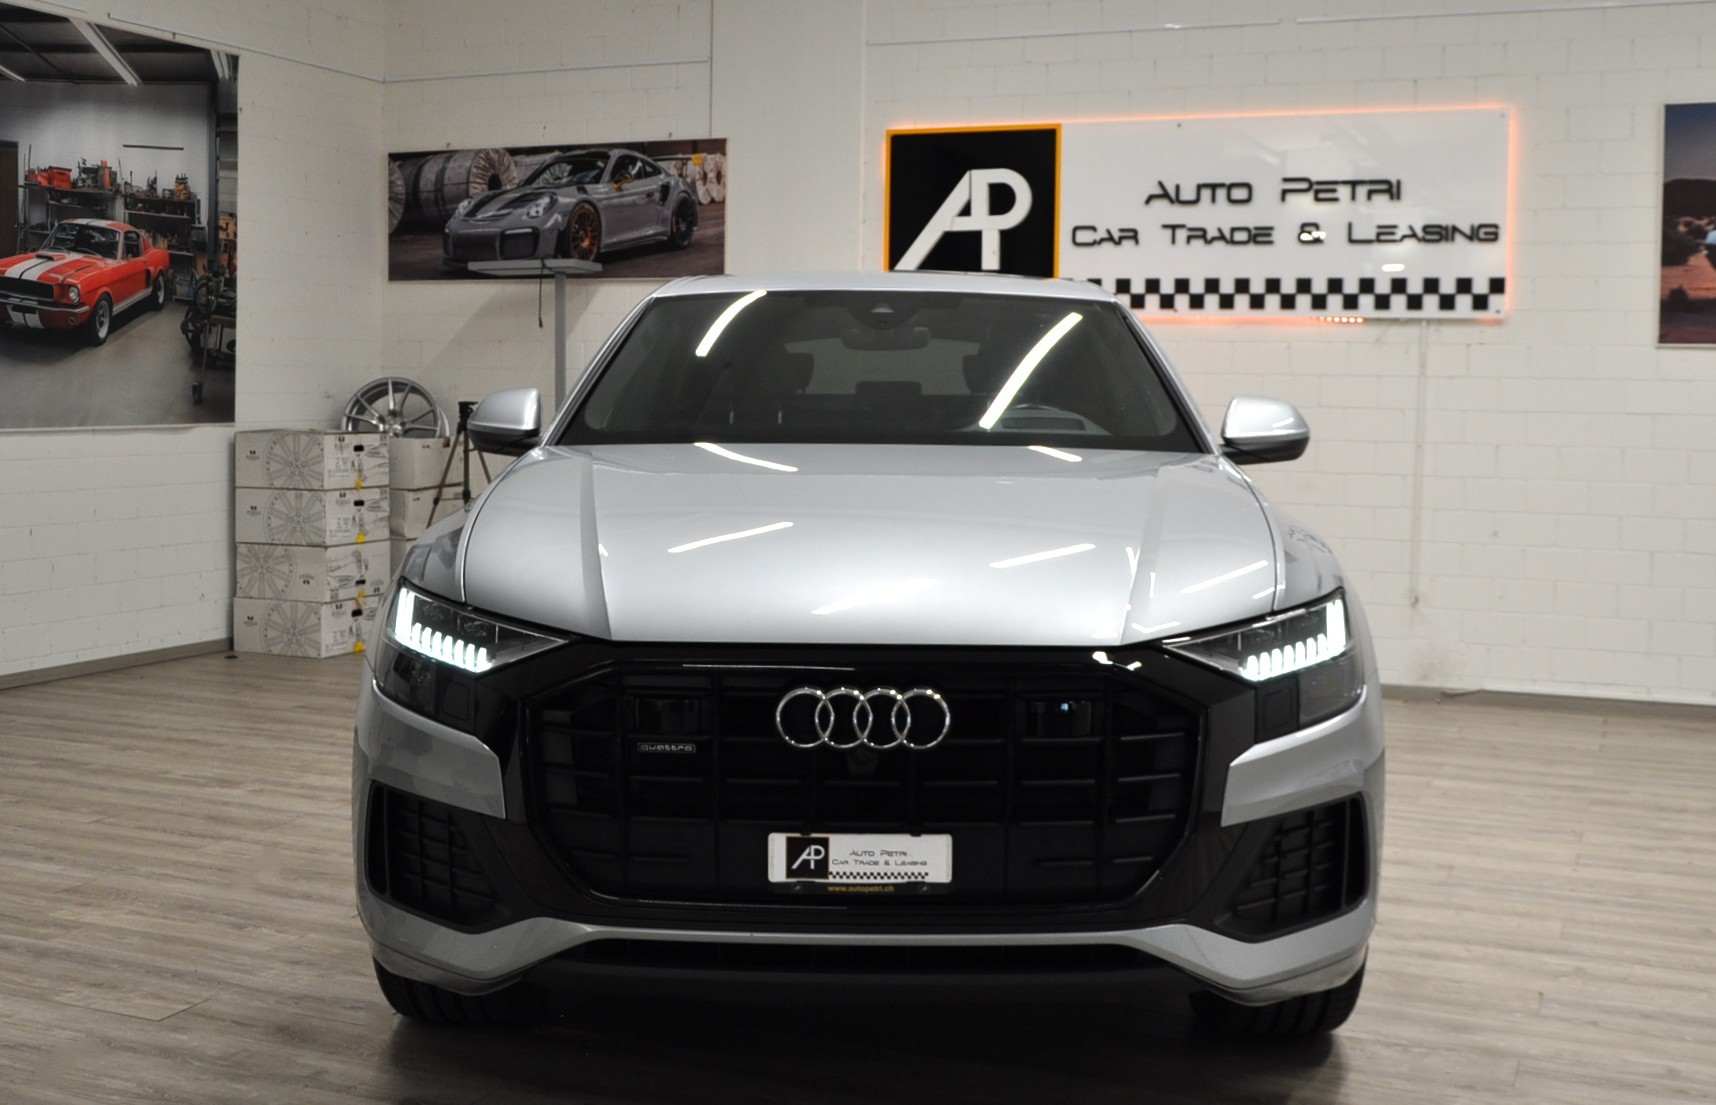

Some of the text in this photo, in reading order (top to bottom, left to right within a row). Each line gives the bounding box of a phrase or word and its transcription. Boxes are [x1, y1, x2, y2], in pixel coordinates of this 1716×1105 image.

[1145, 177, 1403, 205] AUTO PETRI
[895, 168, 1033, 271] AP
[1072, 222, 1500, 247] CAR TRADE & LEASING
[827, 885, 894, 893] www.autopetri.ch
